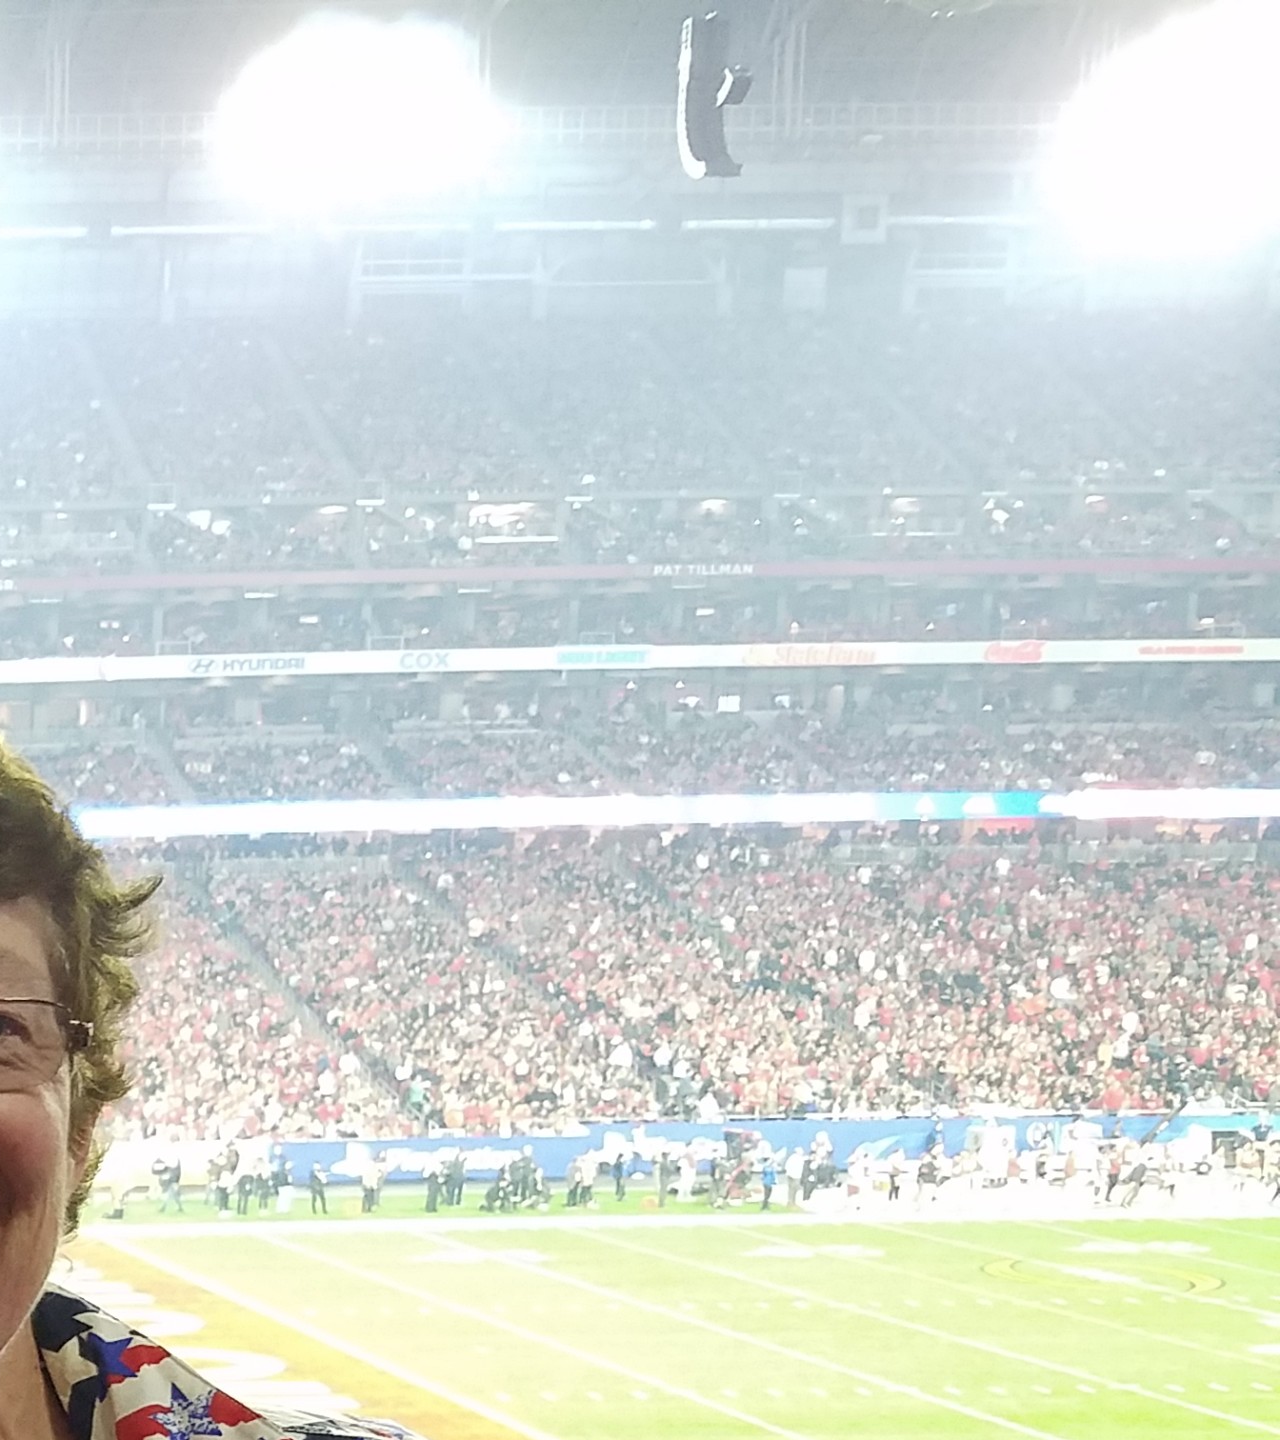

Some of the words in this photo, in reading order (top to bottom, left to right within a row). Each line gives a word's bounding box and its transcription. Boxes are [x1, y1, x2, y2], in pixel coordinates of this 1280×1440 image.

[653, 564, 682, 576] PAT
[687, 564, 753, 576] TILLMAN
[223, 657, 305, 671] HYUNDAI
[400, 651, 450, 670] COX
